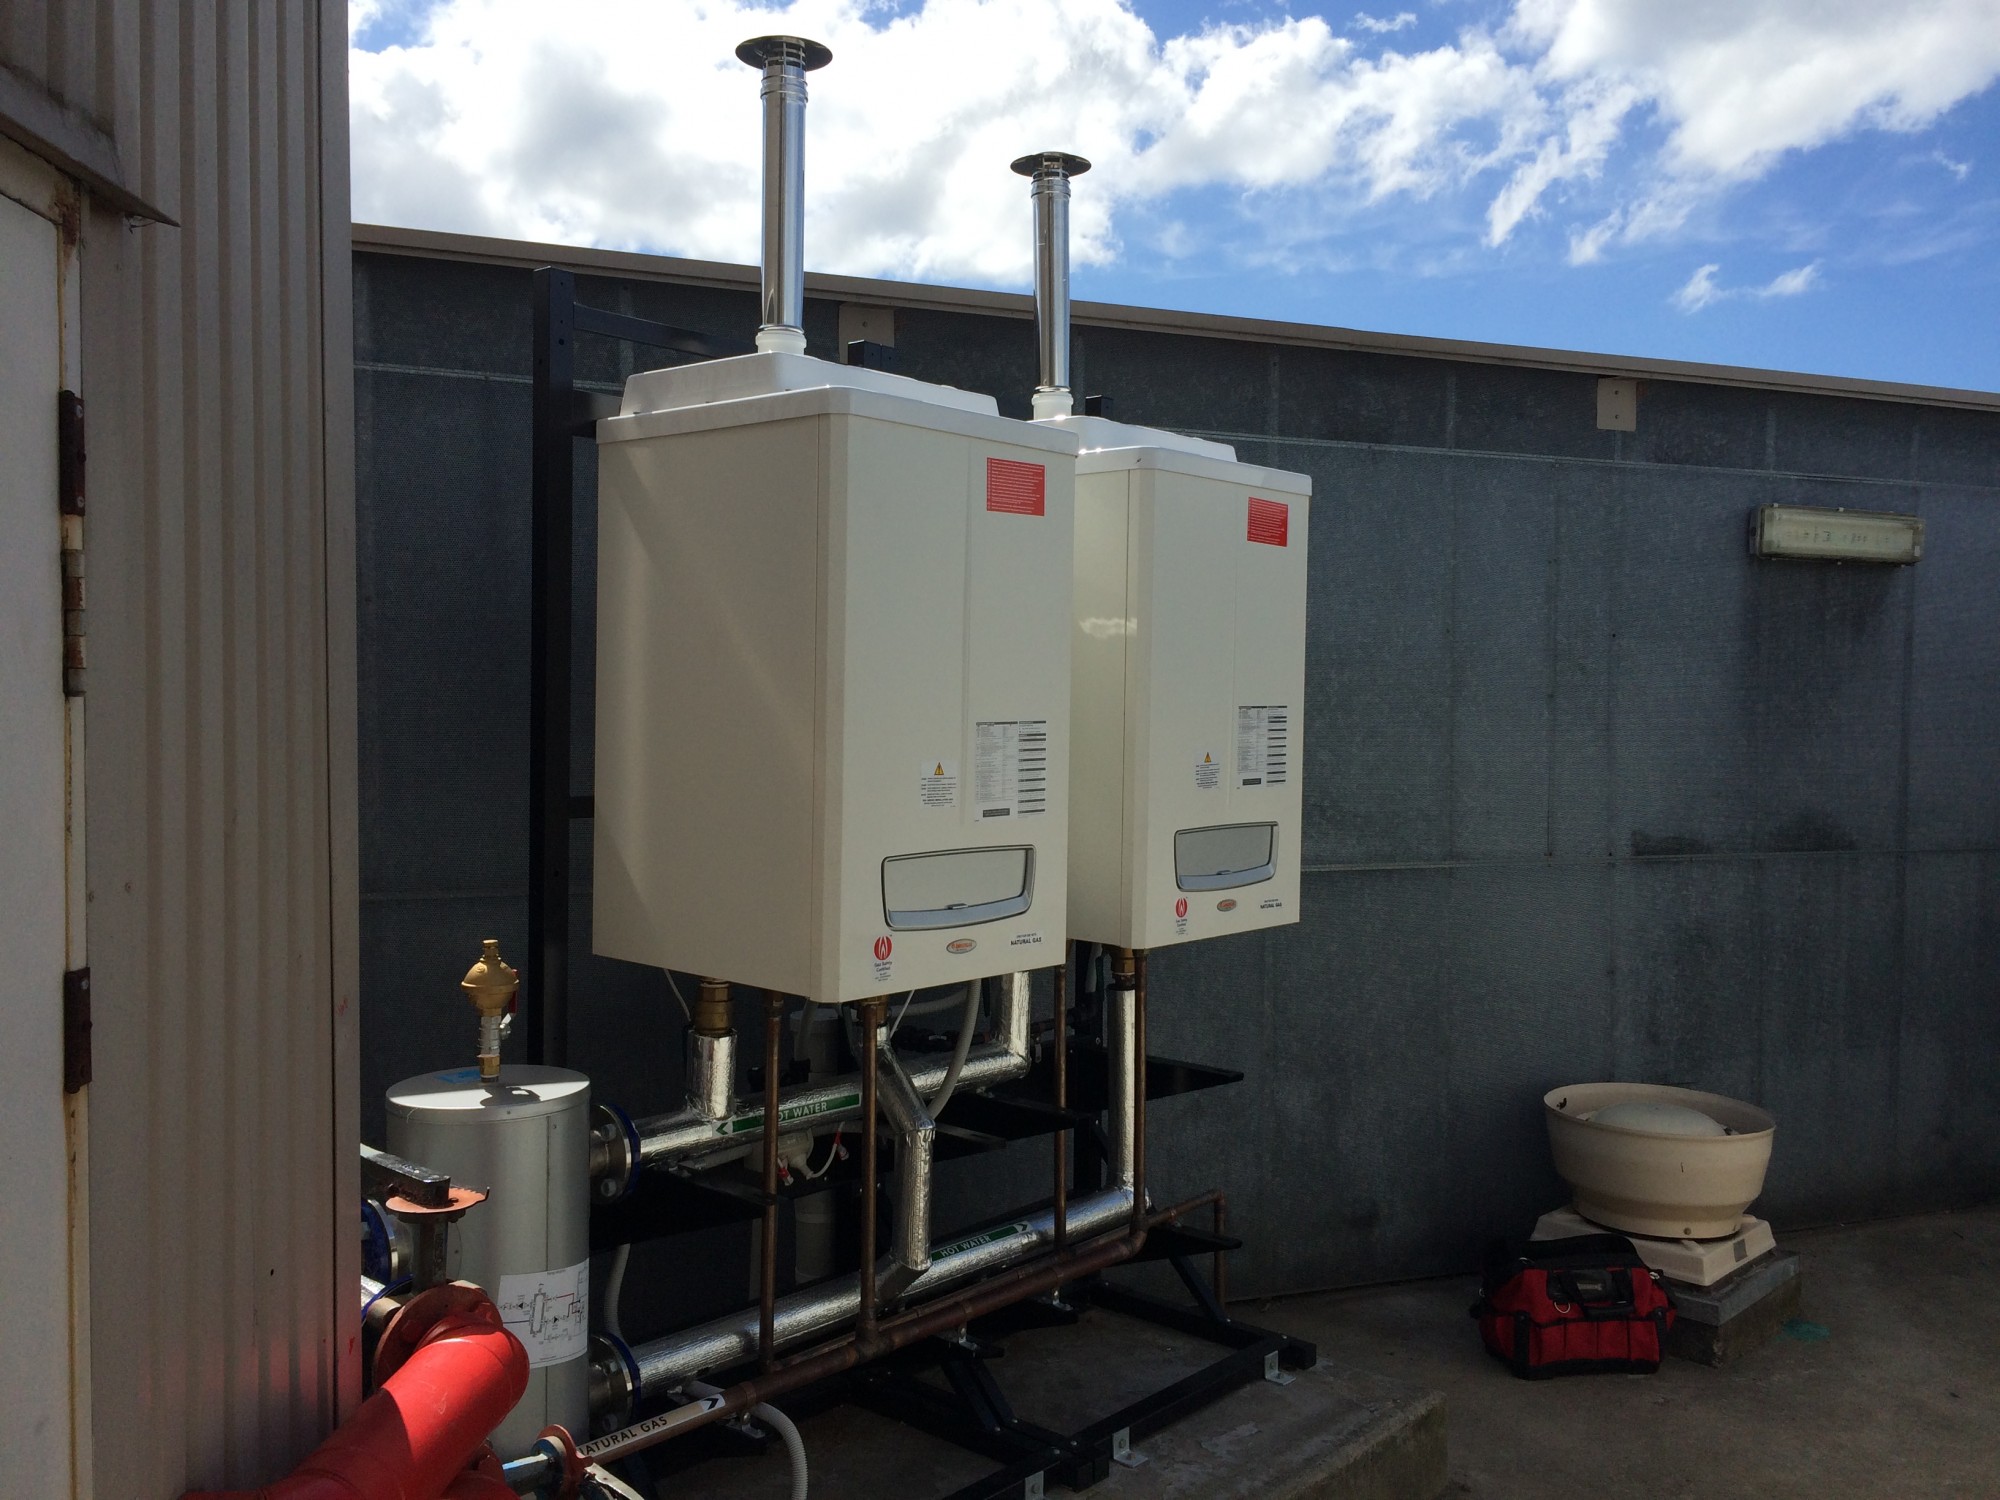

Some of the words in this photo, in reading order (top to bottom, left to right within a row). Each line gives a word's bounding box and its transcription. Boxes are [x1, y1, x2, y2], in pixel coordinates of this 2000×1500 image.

[1010, 938, 1031, 946] NATURAL
[793, 1102, 827, 1118] WATER
[940, 1246, 960, 1258] HOT
[961, 1235, 992, 1250] WATER
[640, 1416, 668, 1433] GAS
